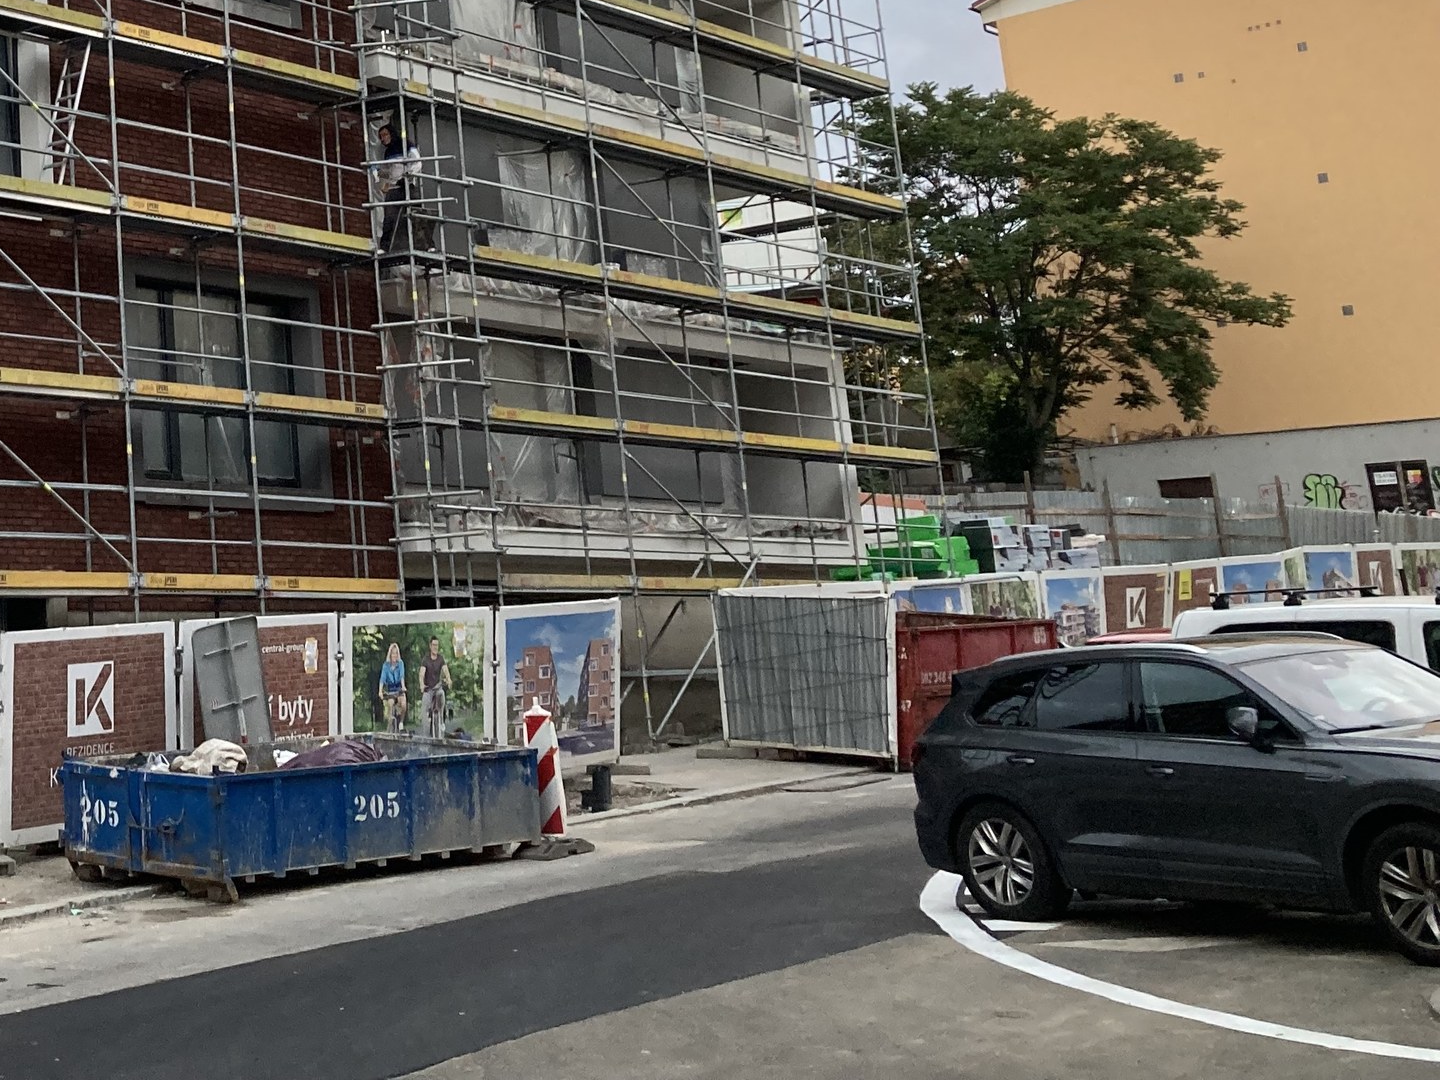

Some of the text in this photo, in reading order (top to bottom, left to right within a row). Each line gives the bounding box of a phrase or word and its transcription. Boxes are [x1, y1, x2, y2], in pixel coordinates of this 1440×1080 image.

[262, 643, 305, 654] central-group
[75, 663, 113, 731] K
[278, 695, 313, 725] byty
[66, 743, 115, 757] REZIDENCE
[80, 796, 119, 828] 205
[354, 791, 400, 822] 205
